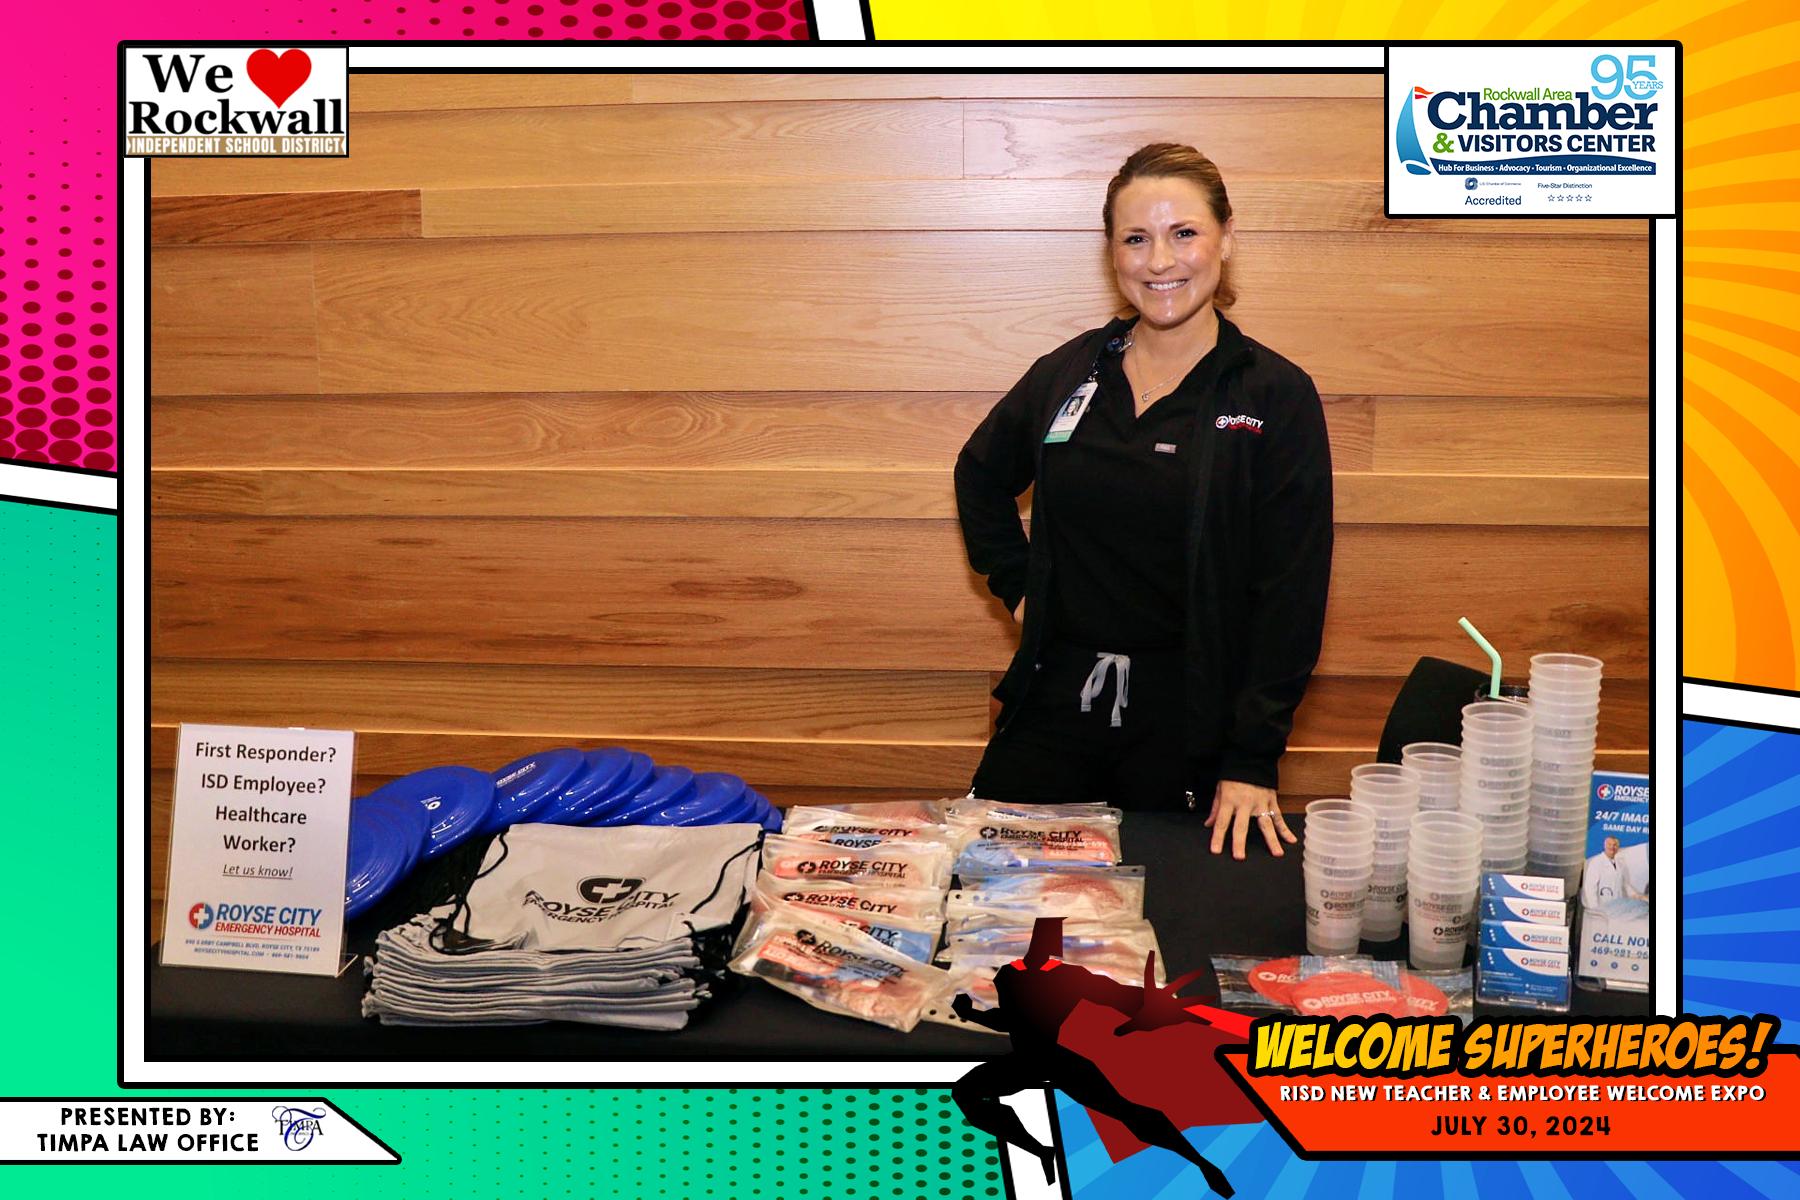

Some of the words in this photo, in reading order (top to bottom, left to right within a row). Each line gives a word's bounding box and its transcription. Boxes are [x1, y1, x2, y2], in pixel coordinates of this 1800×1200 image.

[196, 742, 231, 758] First
[236, 744, 337, 763] Responder?
[201, 773, 228, 789] ISD
[233, 775, 326, 796] Employee?
[215, 805, 307, 825] Healthcare
[1595, 810, 1620, 821] 24/7
[878, 828, 913, 837] CITY
[1049, 830, 1082, 840] CITY
[1603, 823, 1625, 832] SAME
[1625, 825, 1642, 833] DAY
[223, 835, 296, 853] Worker?
[223, 864, 240, 875] Let
[242, 866, 255, 876] us
[258, 865, 293, 878] know!
[819, 860, 868, 871] ROYSE
[872, 861, 908, 873] CITY
[806, 893, 859, 907] ROYSE
[860, 900, 898, 913] CITY
[217, 903, 277, 924] ROYSE
[279, 907, 323, 926] CITY
[215, 922, 274, 935] EMERGENCY
[274, 927, 322, 938] HOSPITAL
[1593, 932, 1623, 945] CALL
[1362, 990, 1390, 1001] CITY
